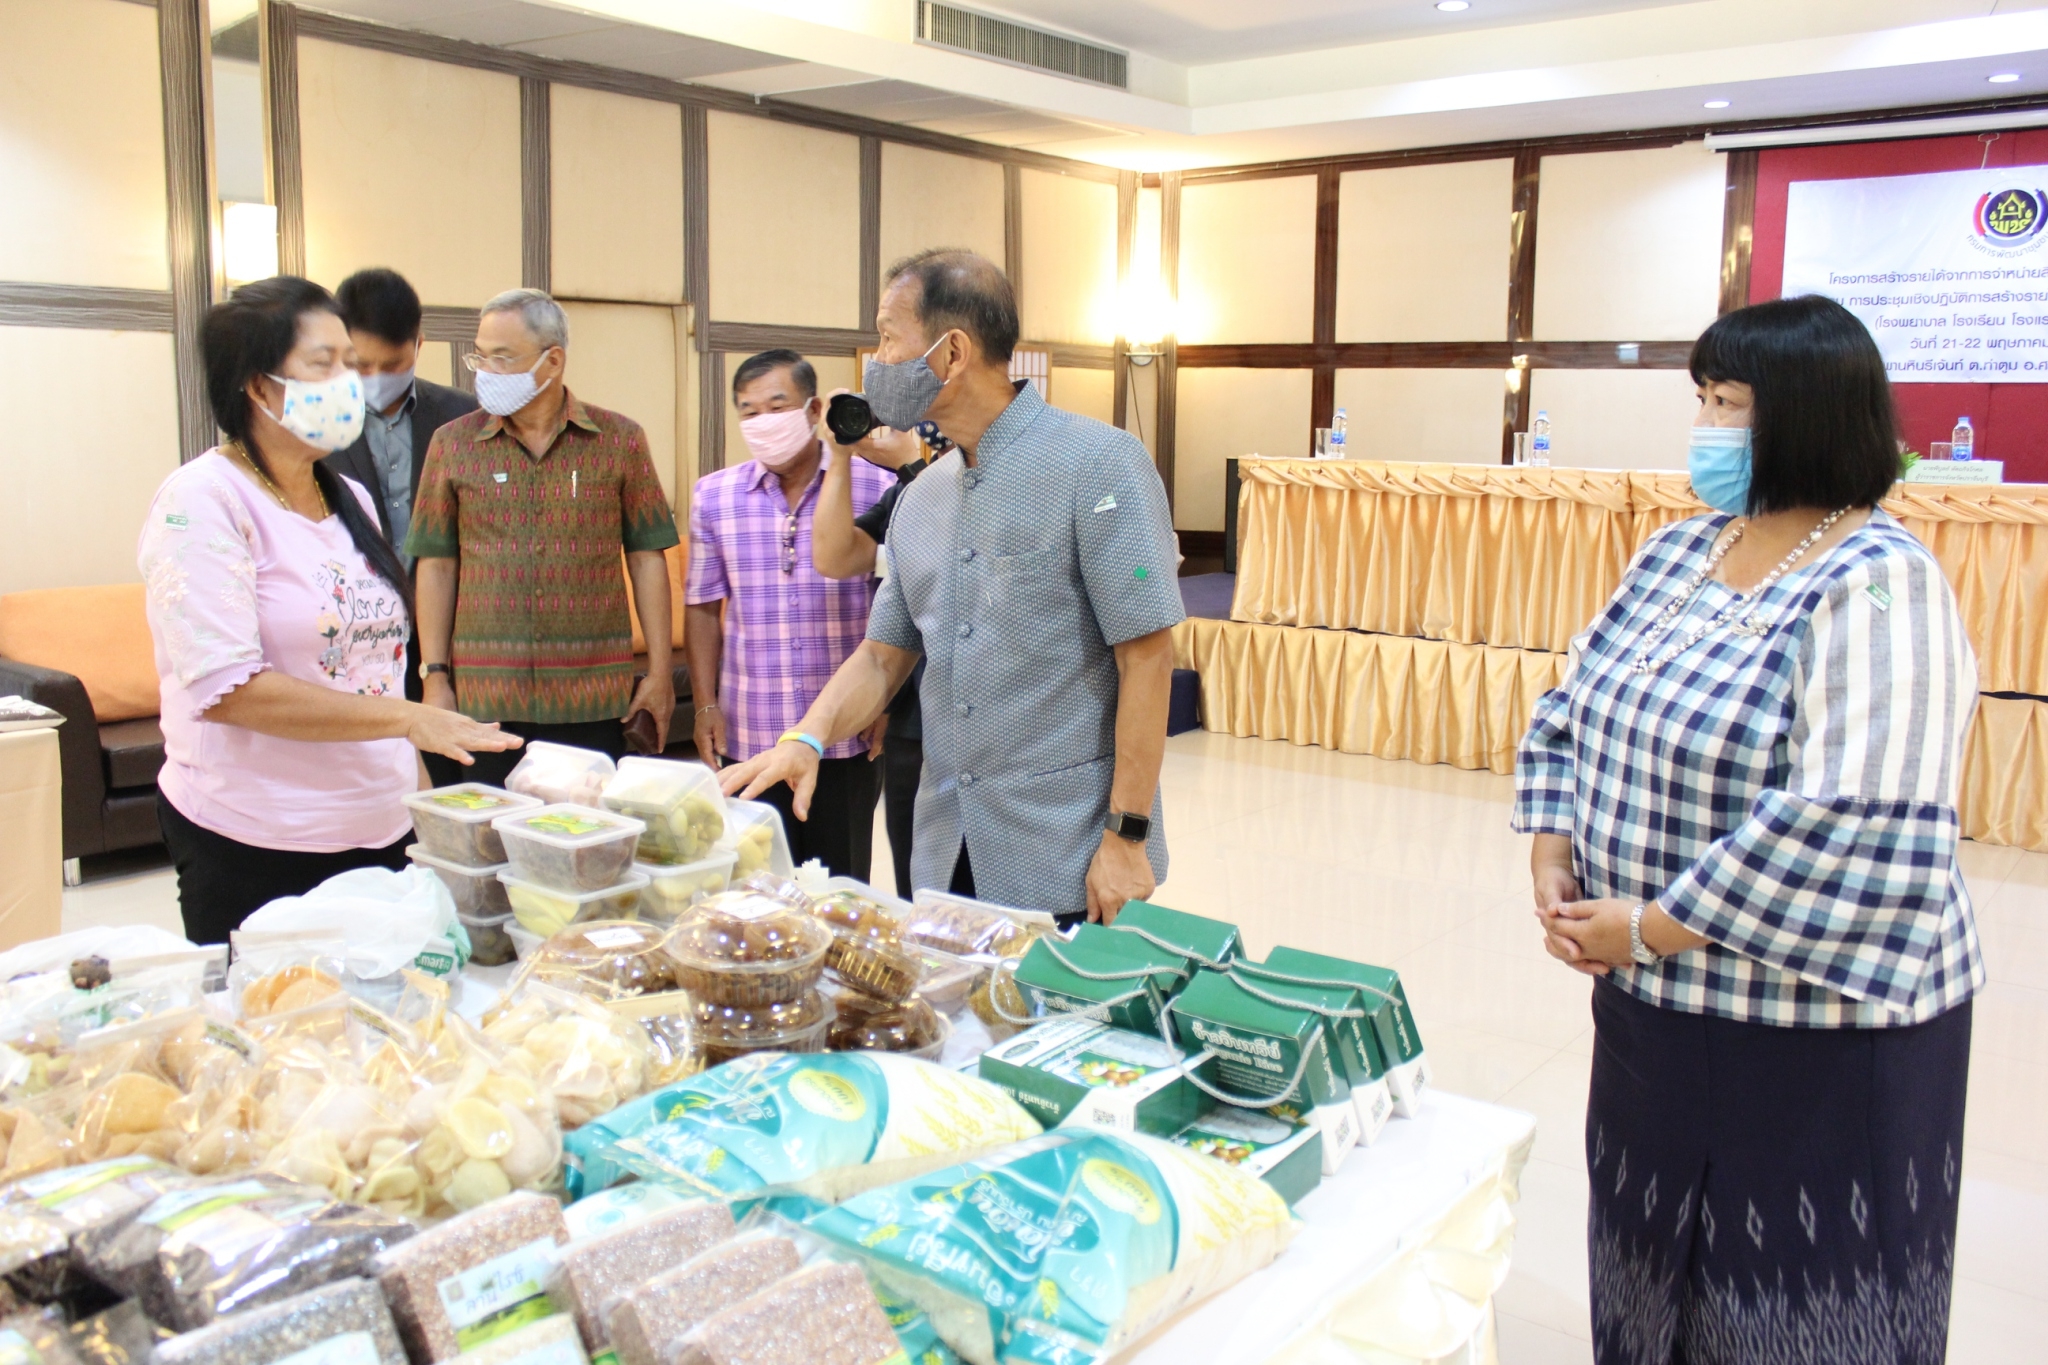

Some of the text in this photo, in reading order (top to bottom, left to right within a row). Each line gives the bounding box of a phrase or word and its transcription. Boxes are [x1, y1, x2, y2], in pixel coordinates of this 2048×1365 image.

[1953, 313, 2005, 327] โรงเรียน
[1910, 335, 1937, 349] วันที่
[1942, 338, 1981, 349] 21-22
[345, 586, 396, 636] love
[1191, 1020, 1281, 1060] ข้าวอินทรีย์
